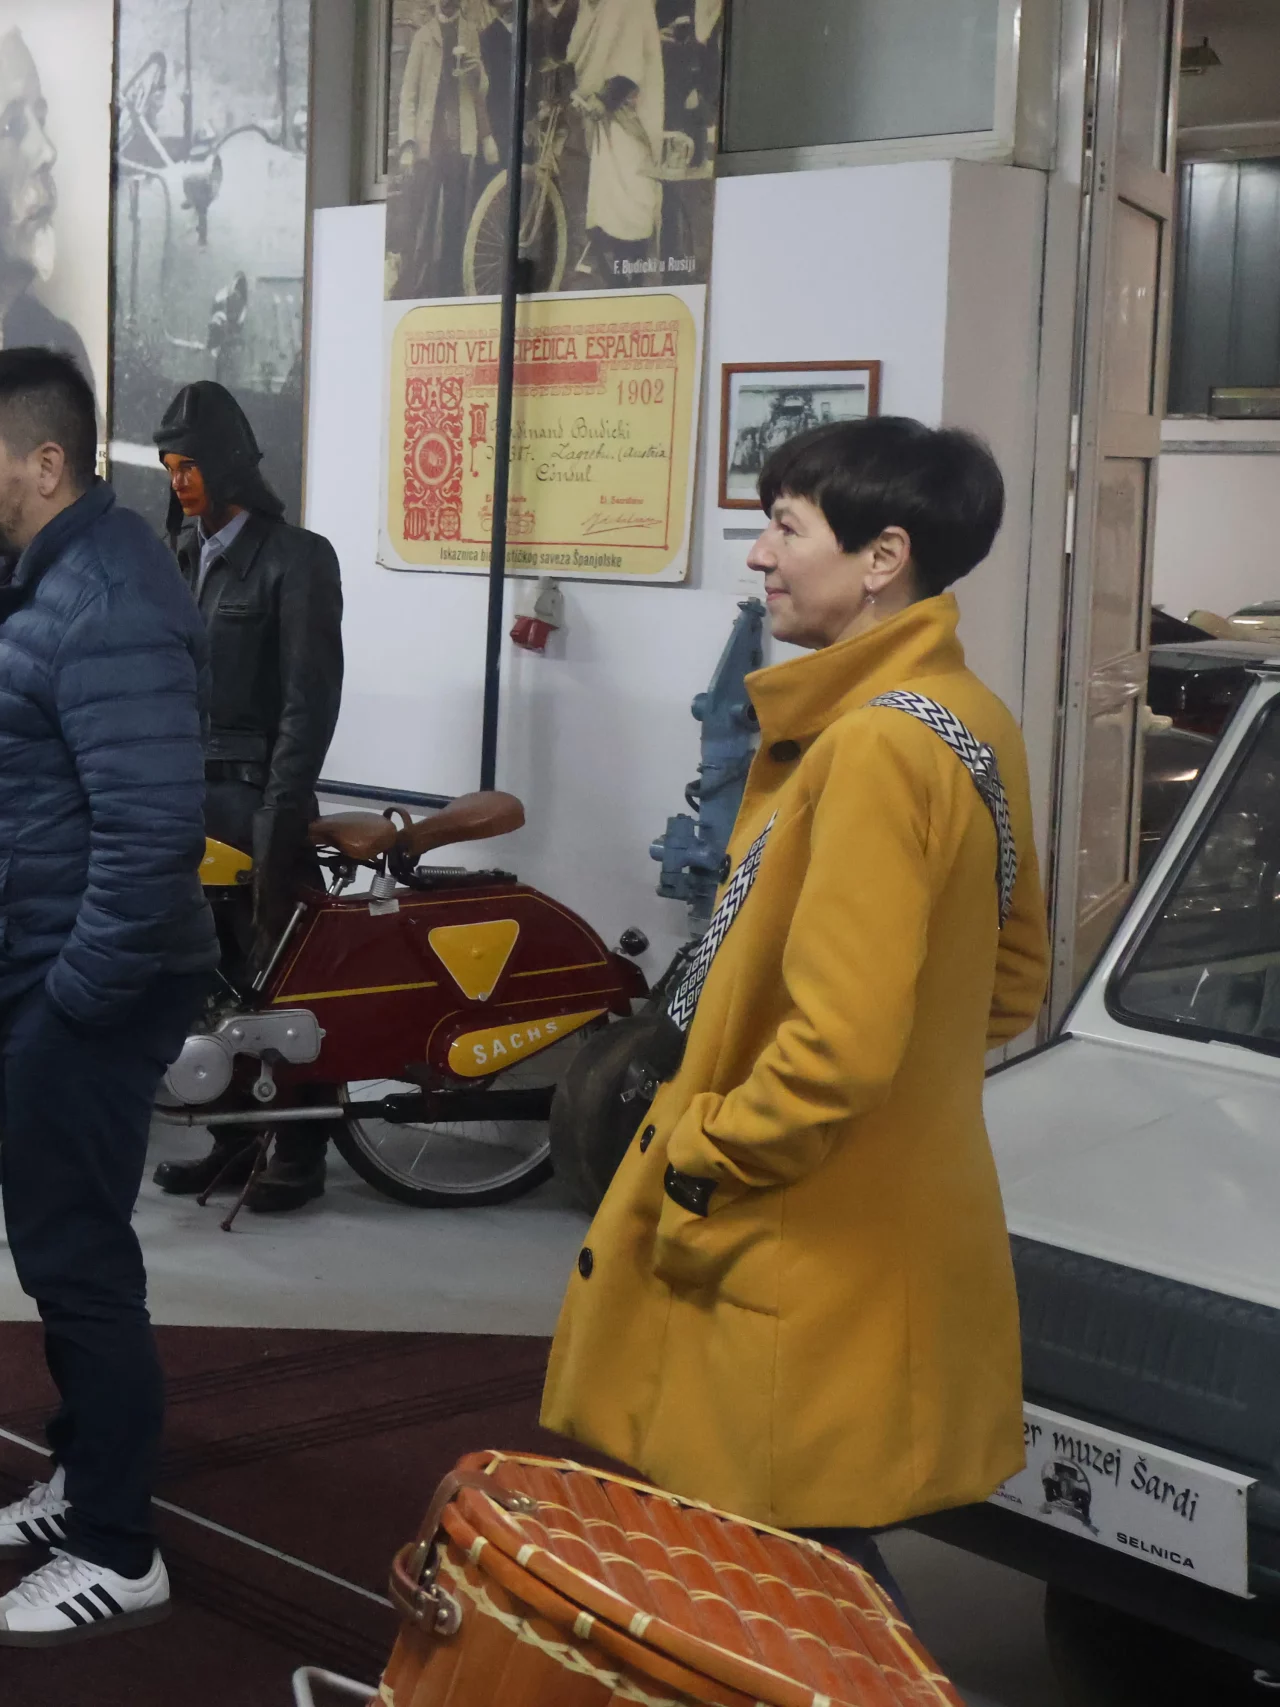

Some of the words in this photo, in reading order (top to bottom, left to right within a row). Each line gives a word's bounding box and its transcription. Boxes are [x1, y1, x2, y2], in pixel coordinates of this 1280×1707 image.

[622, 258, 658, 274] Budicki
[668, 256, 696, 273] Rusiji
[585, 330, 676, 361] ESPAÑOLA
[617, 378, 665, 406] 1902
[440, 547, 479, 561] Iskaznica
[540, 551, 570, 565] saveza
[572, 549, 623, 568] Španjolske
[472, 1021, 559, 1065] SACHS
[1052, 1431, 1122, 1487] muzej
[1130, 1455, 1200, 1522] Šardi
[1116, 1531, 1196, 1570] SELNICA
